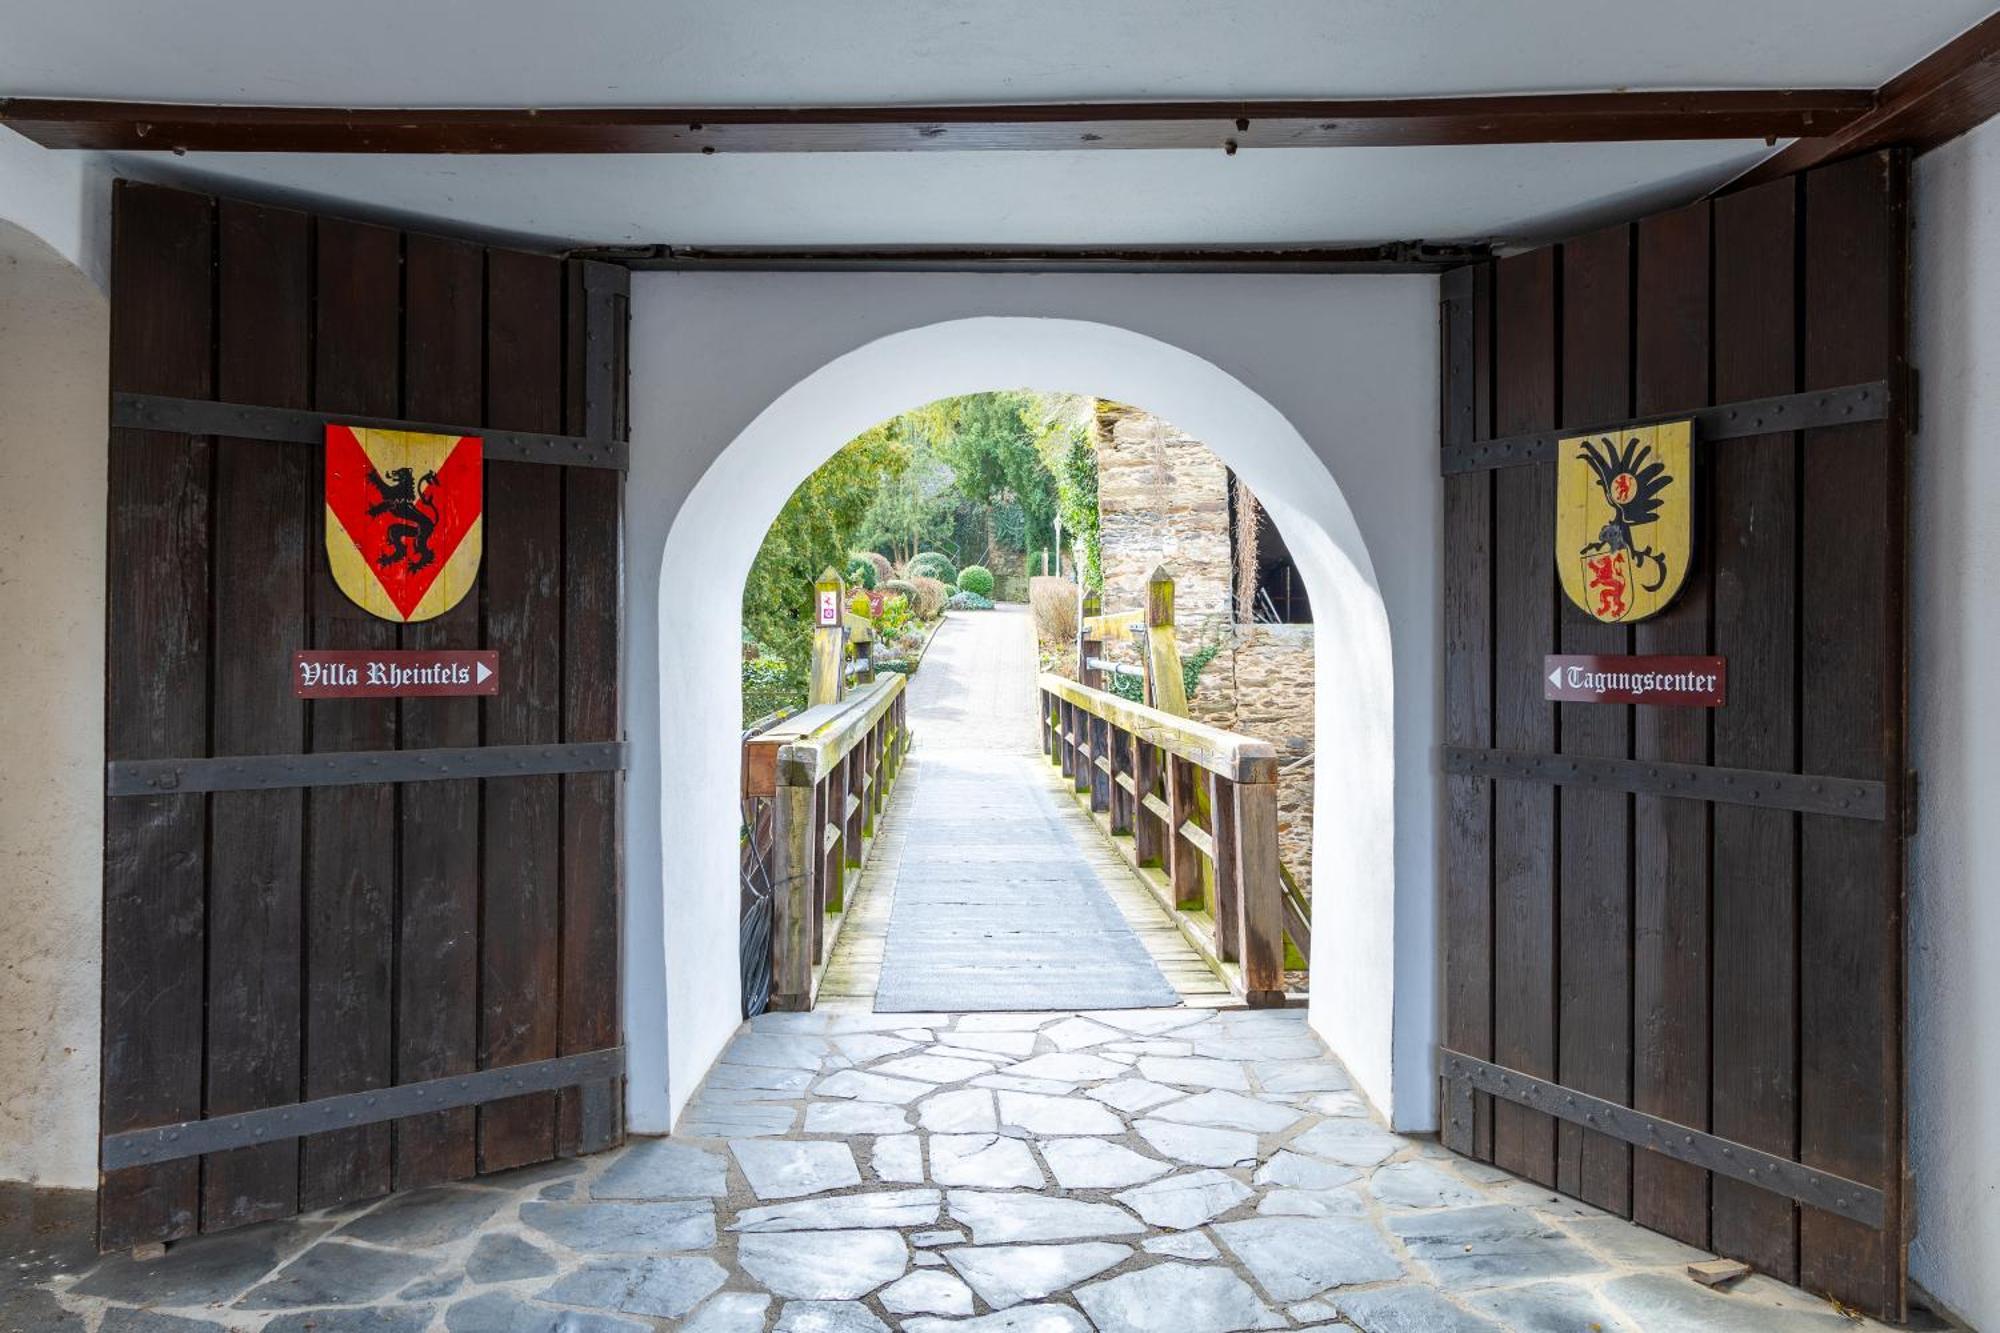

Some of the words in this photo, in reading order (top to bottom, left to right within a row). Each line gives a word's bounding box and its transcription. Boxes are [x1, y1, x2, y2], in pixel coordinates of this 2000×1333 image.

[300, 662, 358, 686] Villa
[367, 661, 470, 688] Rheinfels
[1567, 666, 1716, 694] Tagungscenter
